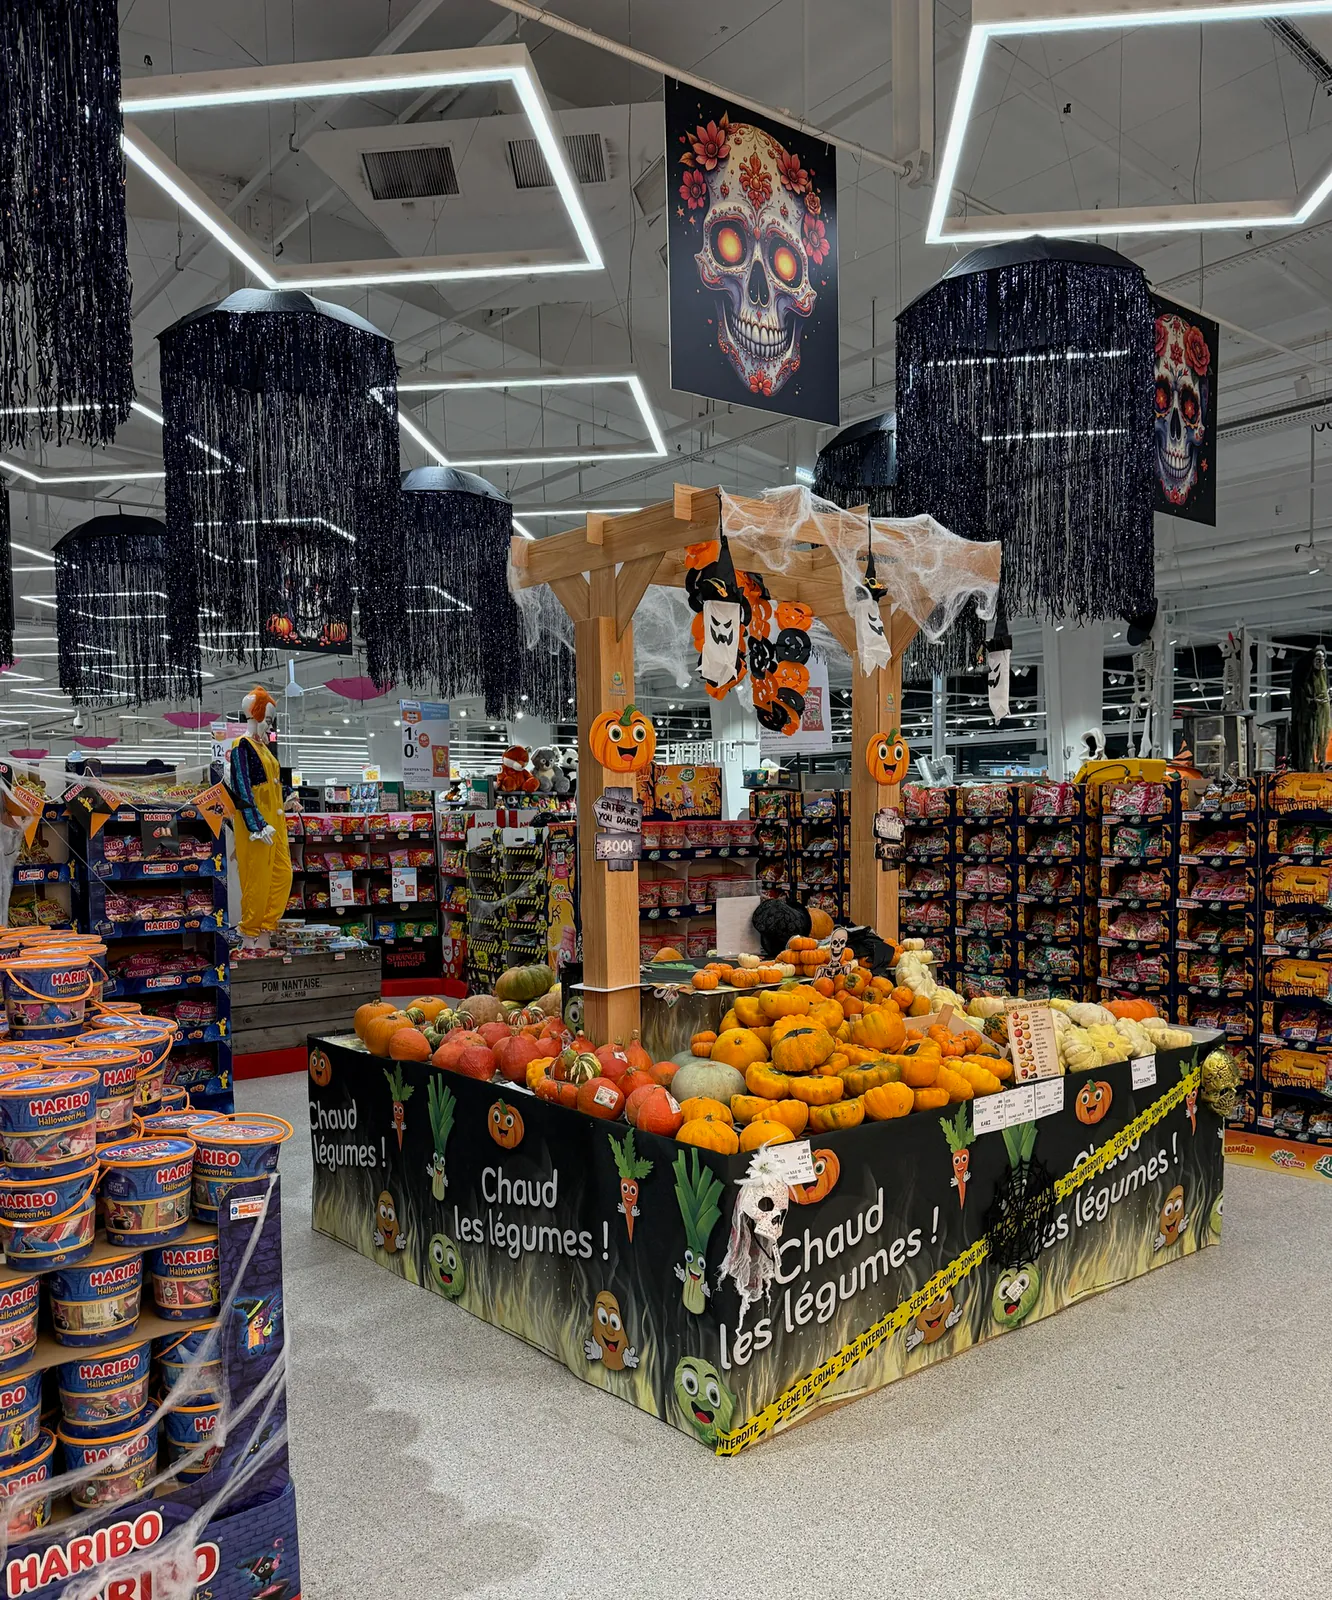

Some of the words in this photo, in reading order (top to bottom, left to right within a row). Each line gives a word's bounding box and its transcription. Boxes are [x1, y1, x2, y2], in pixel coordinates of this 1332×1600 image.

[601, 802, 626, 813] ENTER
[630, 807, 638, 816] IF
[1278, 799, 1318, 815] HALLOWEEN
[144, 813, 172, 821] HARIBO
[598, 812, 612, 822] YOU
[604, 839, 633, 854] BOO!
[143, 863, 179, 874] HBO
[1275, 894, 1314, 907] HALLOWEEN
[145, 920, 180, 931] HARIBO
[386, 952, 426, 965] STRANGER
[52, 972, 88, 986] HARIB
[262, 981, 279, 993] POM
[1275, 986, 1314, 998] HALLOWEEN
[1272, 1077, 1311, 1089] HALLOWEEN
[30, 1091, 90, 1117] HARIBO
[1152, 1105, 1163, 1120] ZONE
[1163, 1086, 1184, 1111] INTERDITE
[38, 1114, 76, 1126] Halloween
[76, 1110, 86, 1119] Mix
[309, 1099, 357, 1131] Chaud
[1128, 1128, 1135, 1139] DE
[1135, 1115, 1148, 1133] CRIME
[105, 1141, 170, 1157] HARIBO
[314, 1138, 376, 1172] légumes
[381, 1136, 386, 1168] !
[195, 1150, 242, 1168] ARIBO
[156, 1161, 192, 1185] HARIB
[220, 1167, 233, 1177] Mix
[1064, 1173, 1079, 1190] ZONE
[1078, 1153, 1105, 1180] INTERDITE
[1075, 1149, 1170, 1228] légumes
[1172, 1131, 1179, 1165] !
[480, 1166, 558, 1209] Chaud
[37, 1209, 51, 1218] Mix
[453, 1205, 485, 1243] les
[488, 1208, 593, 1260] légumes
[602, 1220, 609, 1261] !
[774, 1187, 884, 1285] Chaud
[90, 1258, 143, 1287] HARIBO
[169, 1266, 206, 1276] Halloween
[97, 1281, 130, 1296] Halloween
[720, 1316, 773, 1371] les
[783, 1227, 922, 1333] légumes
[930, 1205, 940, 1244] !
[909, 1292, 930, 1313] SCÈNE
[930, 1283, 939, 1296] DE
[939, 1267, 957, 1289] CRIME
[960, 1253, 976, 1271] ZONE
[0, 1281, 39, 1309] ARIBO
[0, 1307, 26, 1321] alloween
[80, 1354, 140, 1380] HARIBO
[777, 1394, 801, 1415] SCÈNE
[802, 1381, 812, 1397] DE
[813, 1363, 836, 1387] CRIME
[840, 1347, 860, 1368] ZONE
[860, 1318, 895, 1352] INTERDITE
[86, 1375, 121, 1388] Halloween
[121, 1372, 134, 1383] Mix
[6, 1408, 20, 1420] Mix
[716, 1421, 759, 1450] INTERDITE
[0, 1465, 46, 1497] ARIBO
[7, 1510, 163, 1597] HARIBO
